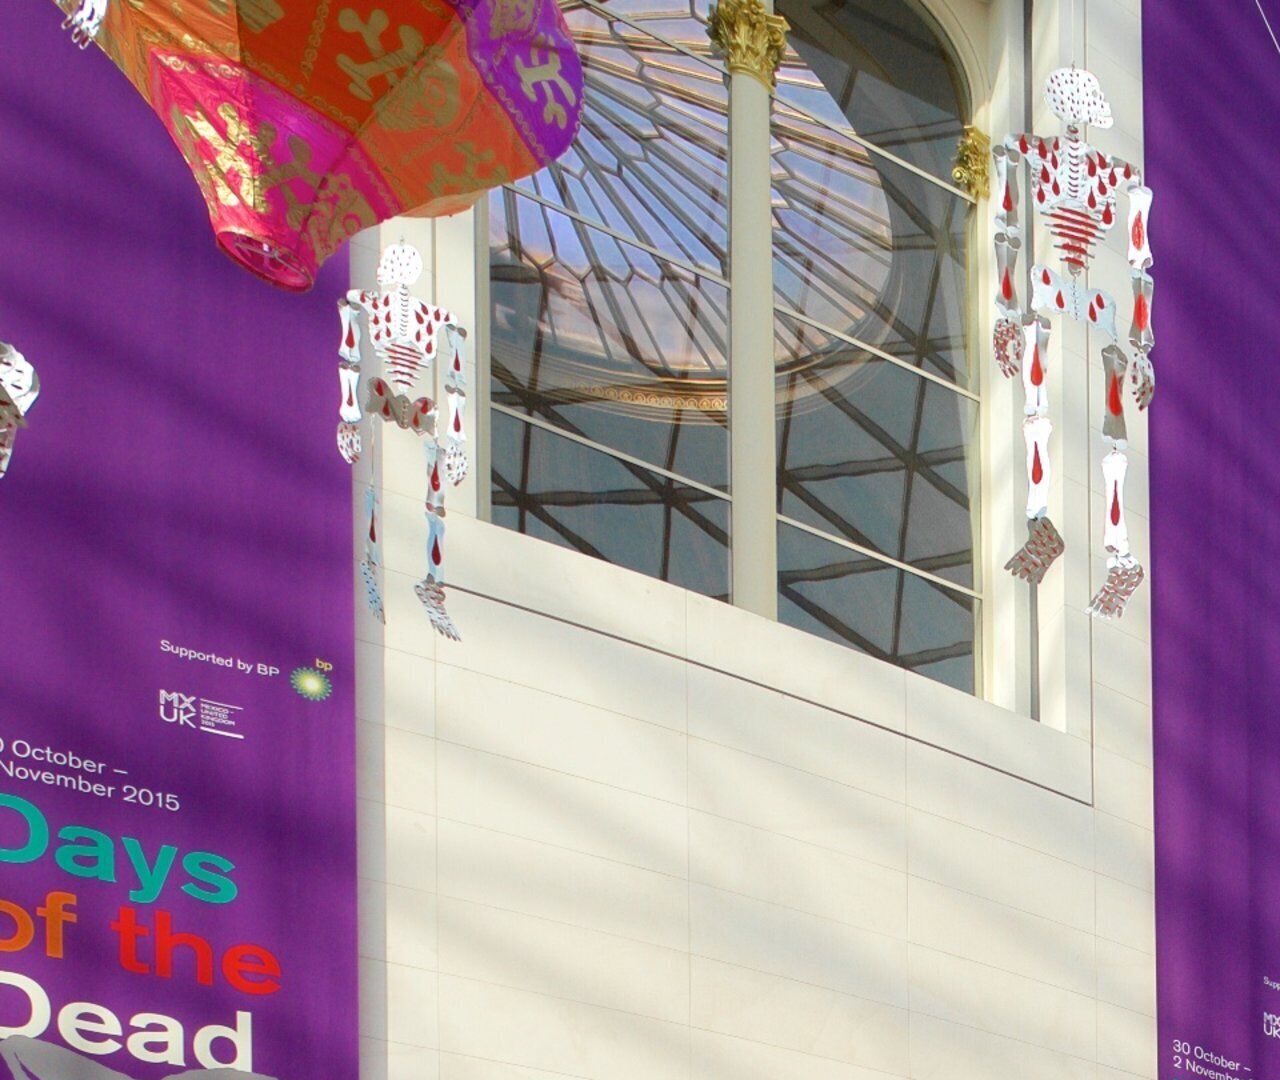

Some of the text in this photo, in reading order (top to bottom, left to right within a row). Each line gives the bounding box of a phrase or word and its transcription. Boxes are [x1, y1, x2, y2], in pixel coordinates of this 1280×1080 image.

[160, 639, 280, 677] Supported by BP
[316, 658, 334, 671] bp
[159, 689, 196, 712] MX
[159, 705, 197, 728] UK
[12, 740, 106, 775] October
[0, 761, 181, 812] November 2015
[0, 793, 238, 903] Days
[111, 907, 282, 995] the
[0, 970, 253, 1073] Dead
[1173, 1040, 1190, 1056] 30
[1194, 1046, 1240, 1072] October
[1173, 1056, 1182, 1068] 2
